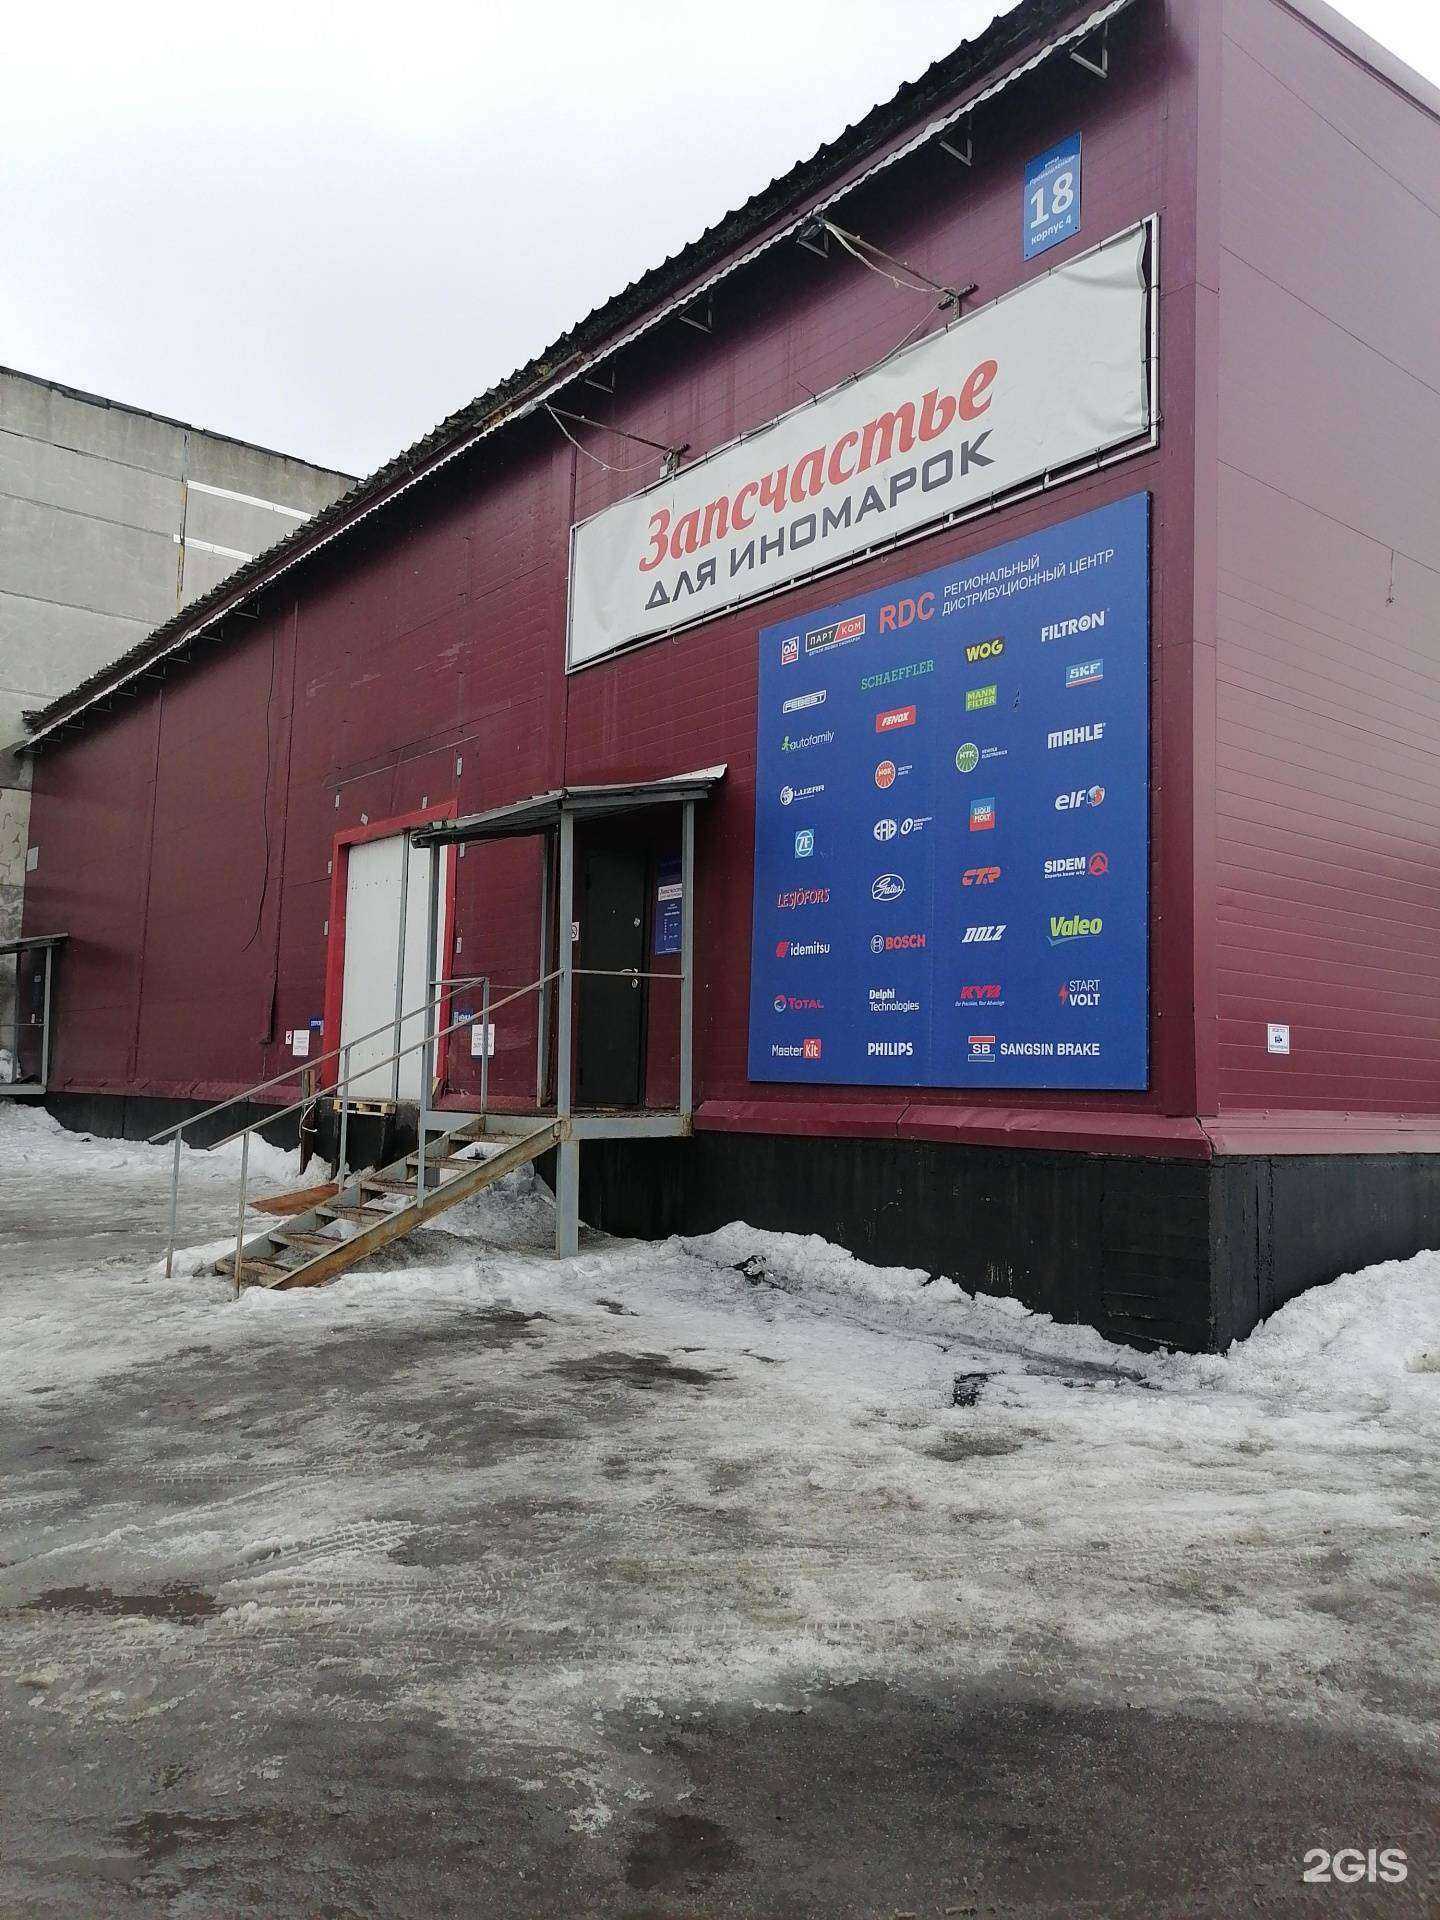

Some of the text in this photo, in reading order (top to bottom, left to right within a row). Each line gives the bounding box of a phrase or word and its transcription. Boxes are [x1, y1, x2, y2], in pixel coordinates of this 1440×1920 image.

[1030, 172, 1073, 228] 18
[1031, 215, 1072, 245] корпус 4
[639, 359, 998, 572] Запсчастье
[644, 429, 995, 610] ДЛЯ ИНОМАРОК
[942, 549, 1114, 616] ДИСТРИБУЦИОННЫЙ ЦЕНТР
[944, 553, 1040, 598] РЕГИОНАЛЬНЫЙ
[879, 591, 936, 635] RDC
[1041, 611, 1105, 642] FILTRON
[966, 639, 1003, 662] WOG
[861, 659, 934, 690] SCHAEFFLER
[1069, 662, 1101, 679] SKF
[967, 687, 996, 701] MANN
[967, 696, 996, 709] FILTER
[881, 711, 910, 727] FENOX
[789, 730, 835, 751] autofamily
[1048, 723, 1104, 750] MAHLE
[1055, 788, 1087, 811] elf
[1044, 856, 1086, 874] SIDEM
[777, 888, 830, 909] LESJÖFORS
[961, 925, 1008, 943] DOLZ
[1050, 915, 1103, 937] Valeo
[790, 941, 831, 956] idemitsu
[885, 934, 926, 950] BOSCH
[869, 988, 895, 1000] Delphi
[1069, 979, 1100, 992] START
[869, 1000, 920, 1013] Technologies
[1069, 993, 1101, 1006] VOLT
[771, 1044, 804, 1057] Master
[867, 1042, 914, 1056] PHILIPS
[972, 1044, 991, 1054] SB
[1000, 1043, 1100, 1056] SANGSIN BRAKE
